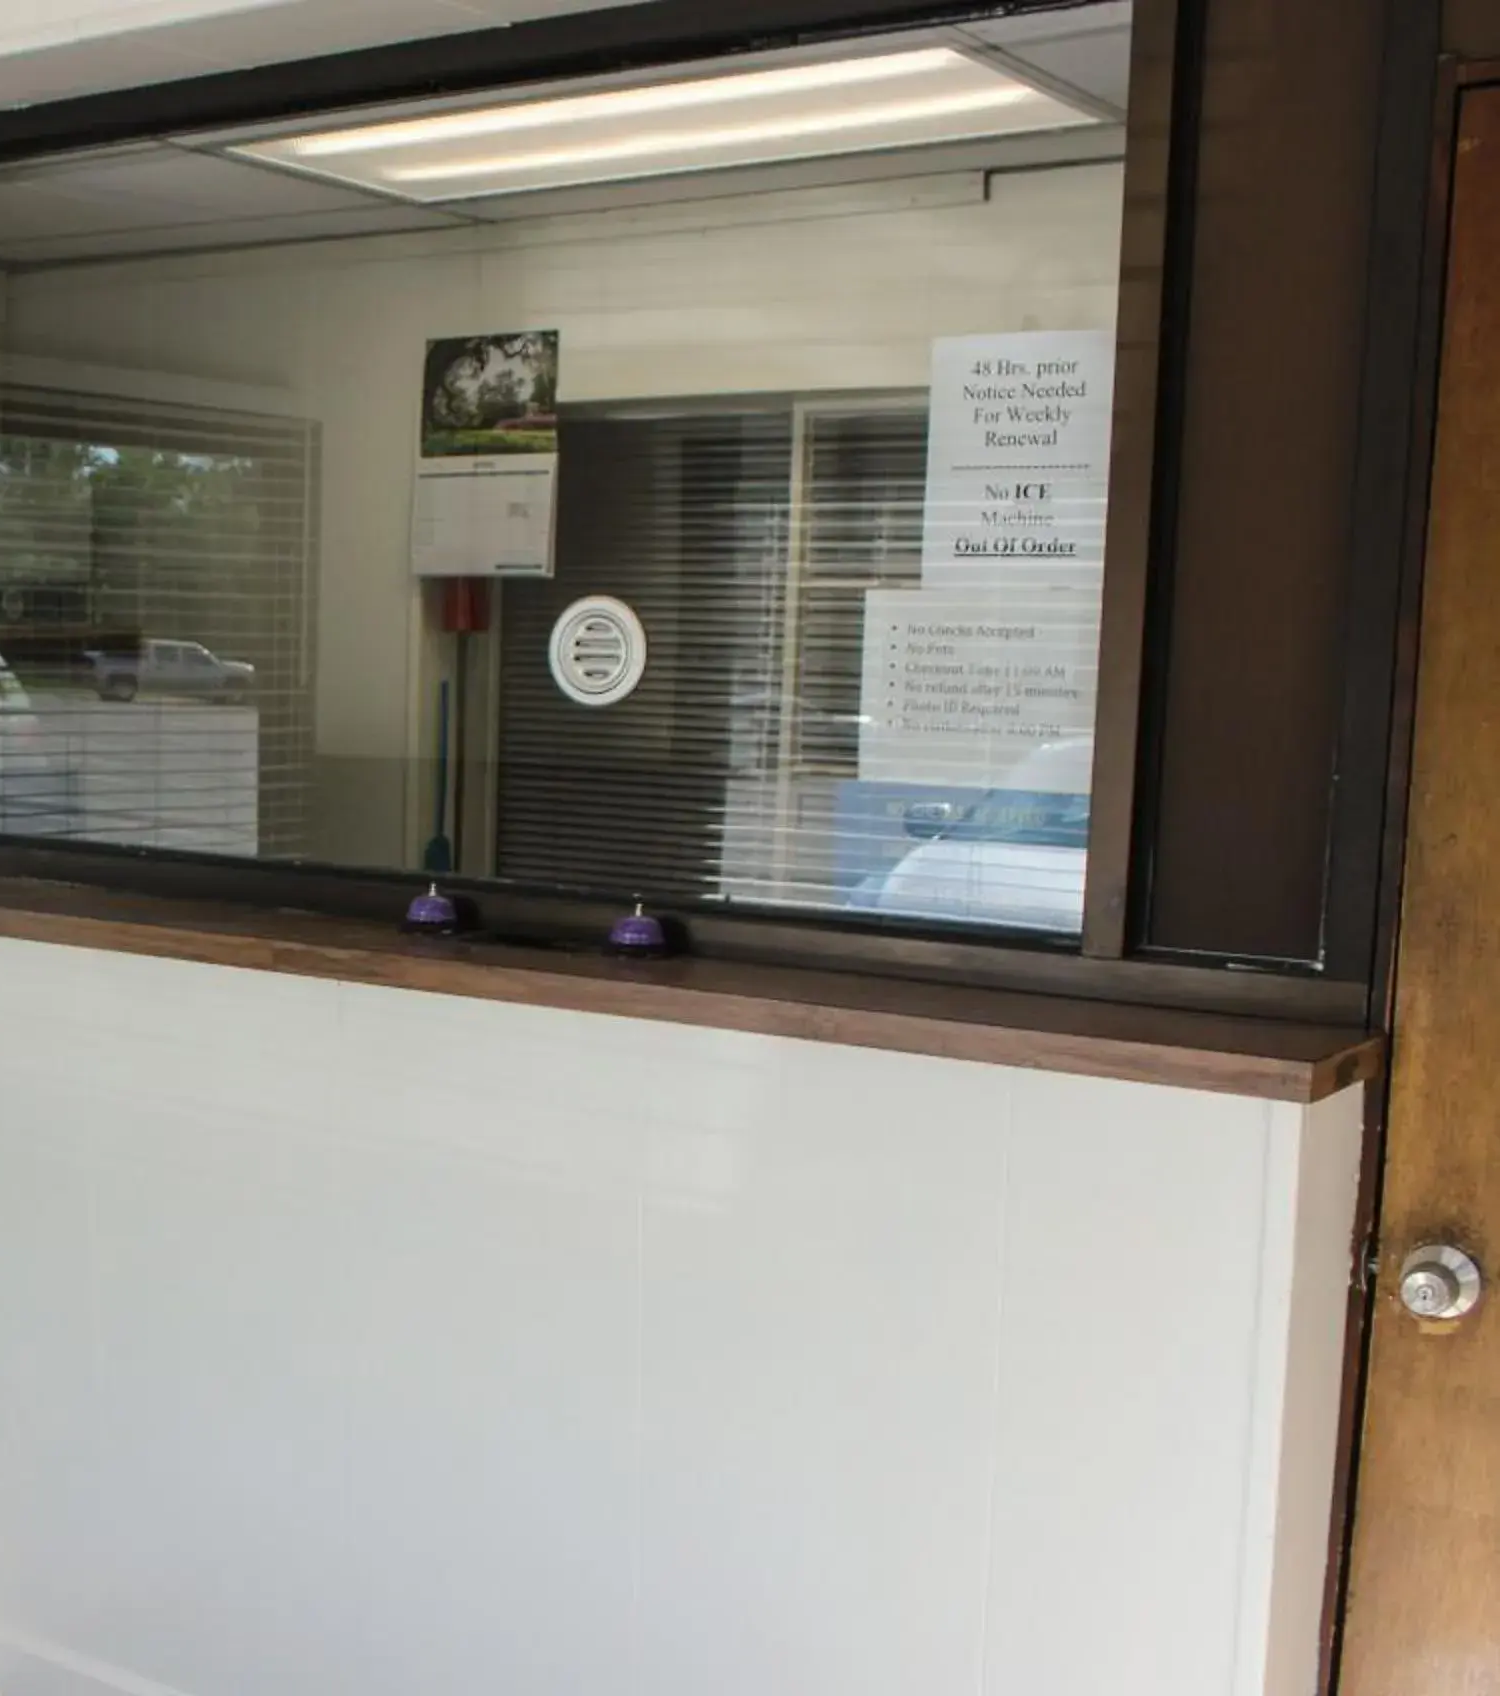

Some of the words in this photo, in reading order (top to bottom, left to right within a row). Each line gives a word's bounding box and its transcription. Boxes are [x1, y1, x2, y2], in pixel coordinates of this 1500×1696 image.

[971, 361, 991, 377] 48
[996, 360, 1030, 376] Hrs.
[1036, 358, 1078, 380] prior
[963, 385, 1015, 401] Notice
[1021, 381, 1086, 399] Needed
[973, 409, 1002, 424] For
[1007, 405, 1072, 427] Weekly
[984, 429, 1058, 447] Renewal
[985, 484, 1009, 500] No
[1014, 483, 1051, 500] ICE
[981, 511, 1055, 528] Machine
[954, 538, 987, 555] Out
[993, 538, 1015, 554] Of
[1021, 537, 1077, 556] Order
[908, 623, 926, 636] No
[976, 625, 1035, 640] Accepted
[905, 643, 924, 656] No
[904, 680, 923, 693] No
[924, 681, 968, 696] refund
[943, 700, 959, 714] ID
[961, 701, 1020, 717] Required
